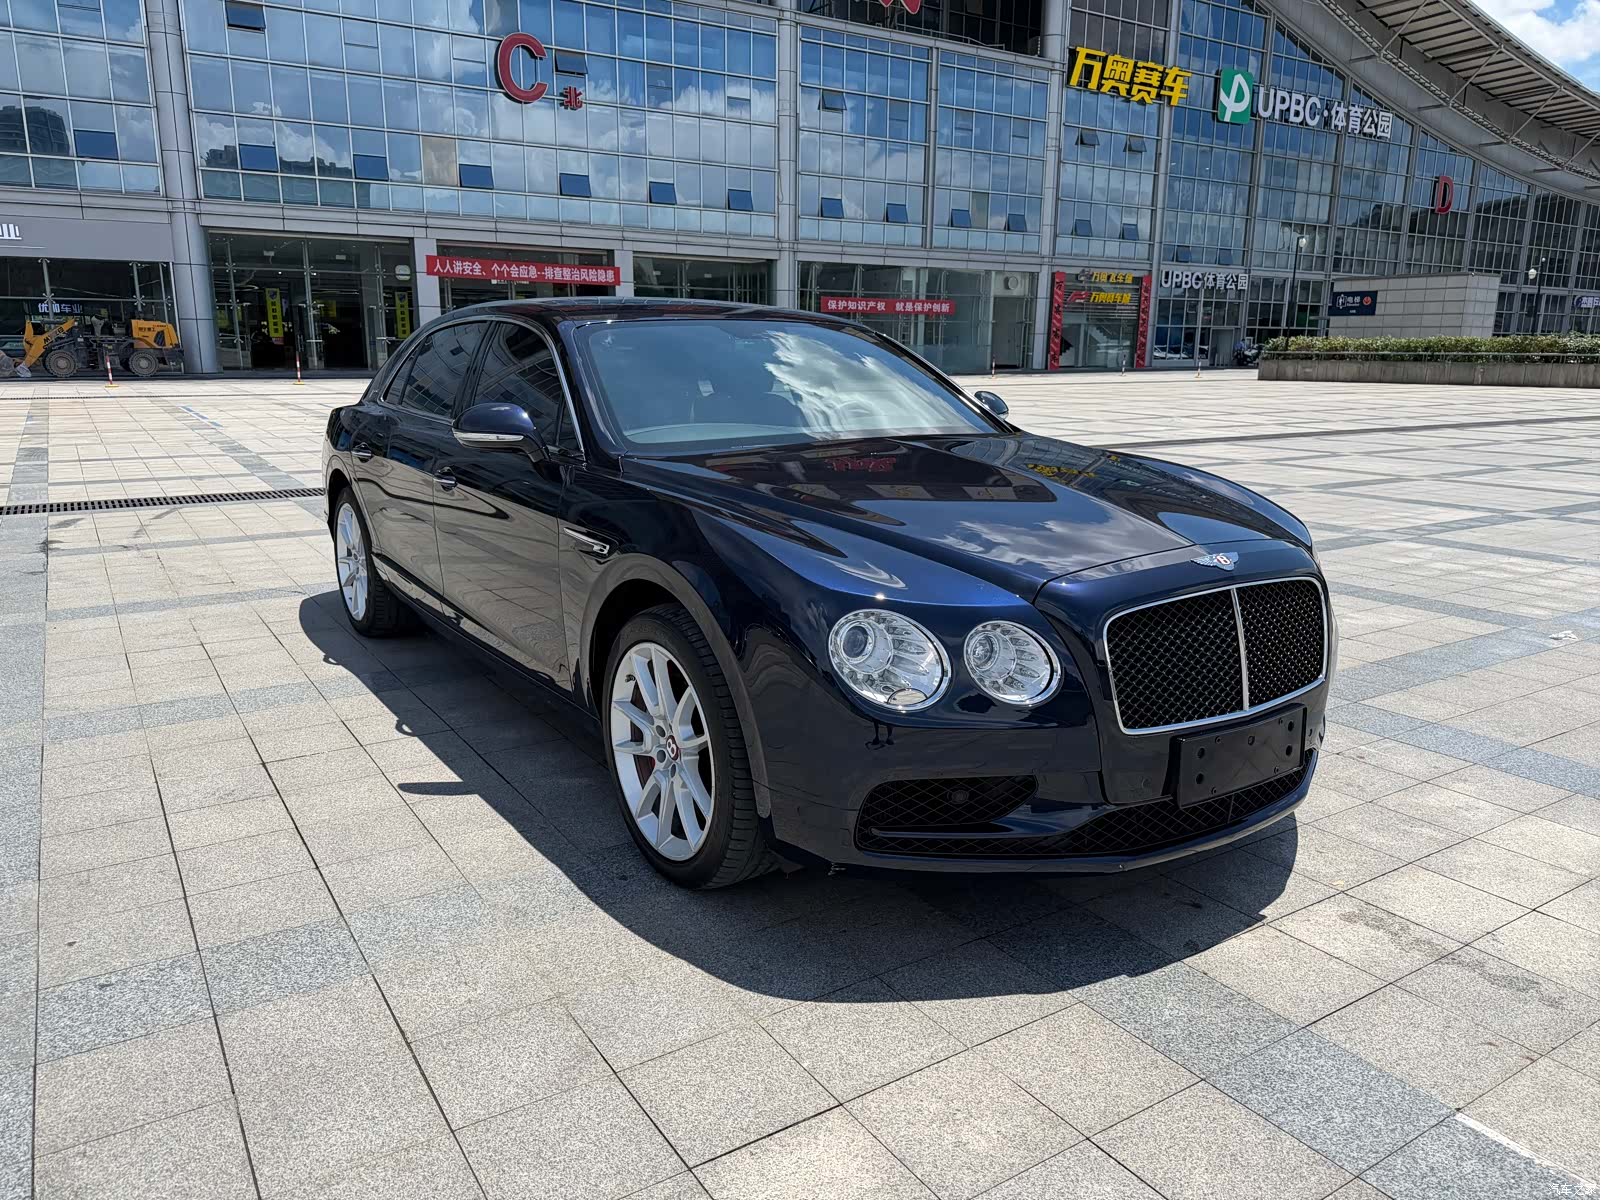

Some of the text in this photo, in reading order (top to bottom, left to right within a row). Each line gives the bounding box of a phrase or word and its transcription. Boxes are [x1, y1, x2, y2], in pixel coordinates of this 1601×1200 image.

[496, 32, 548, 103] C
[1069, 46, 1192, 106] 万奥赛车
[563, 86, 583, 110] 北
[1436, 175, 1454, 214] D
[827, 300, 950, 313] 保护知识产权 就是保护创新
